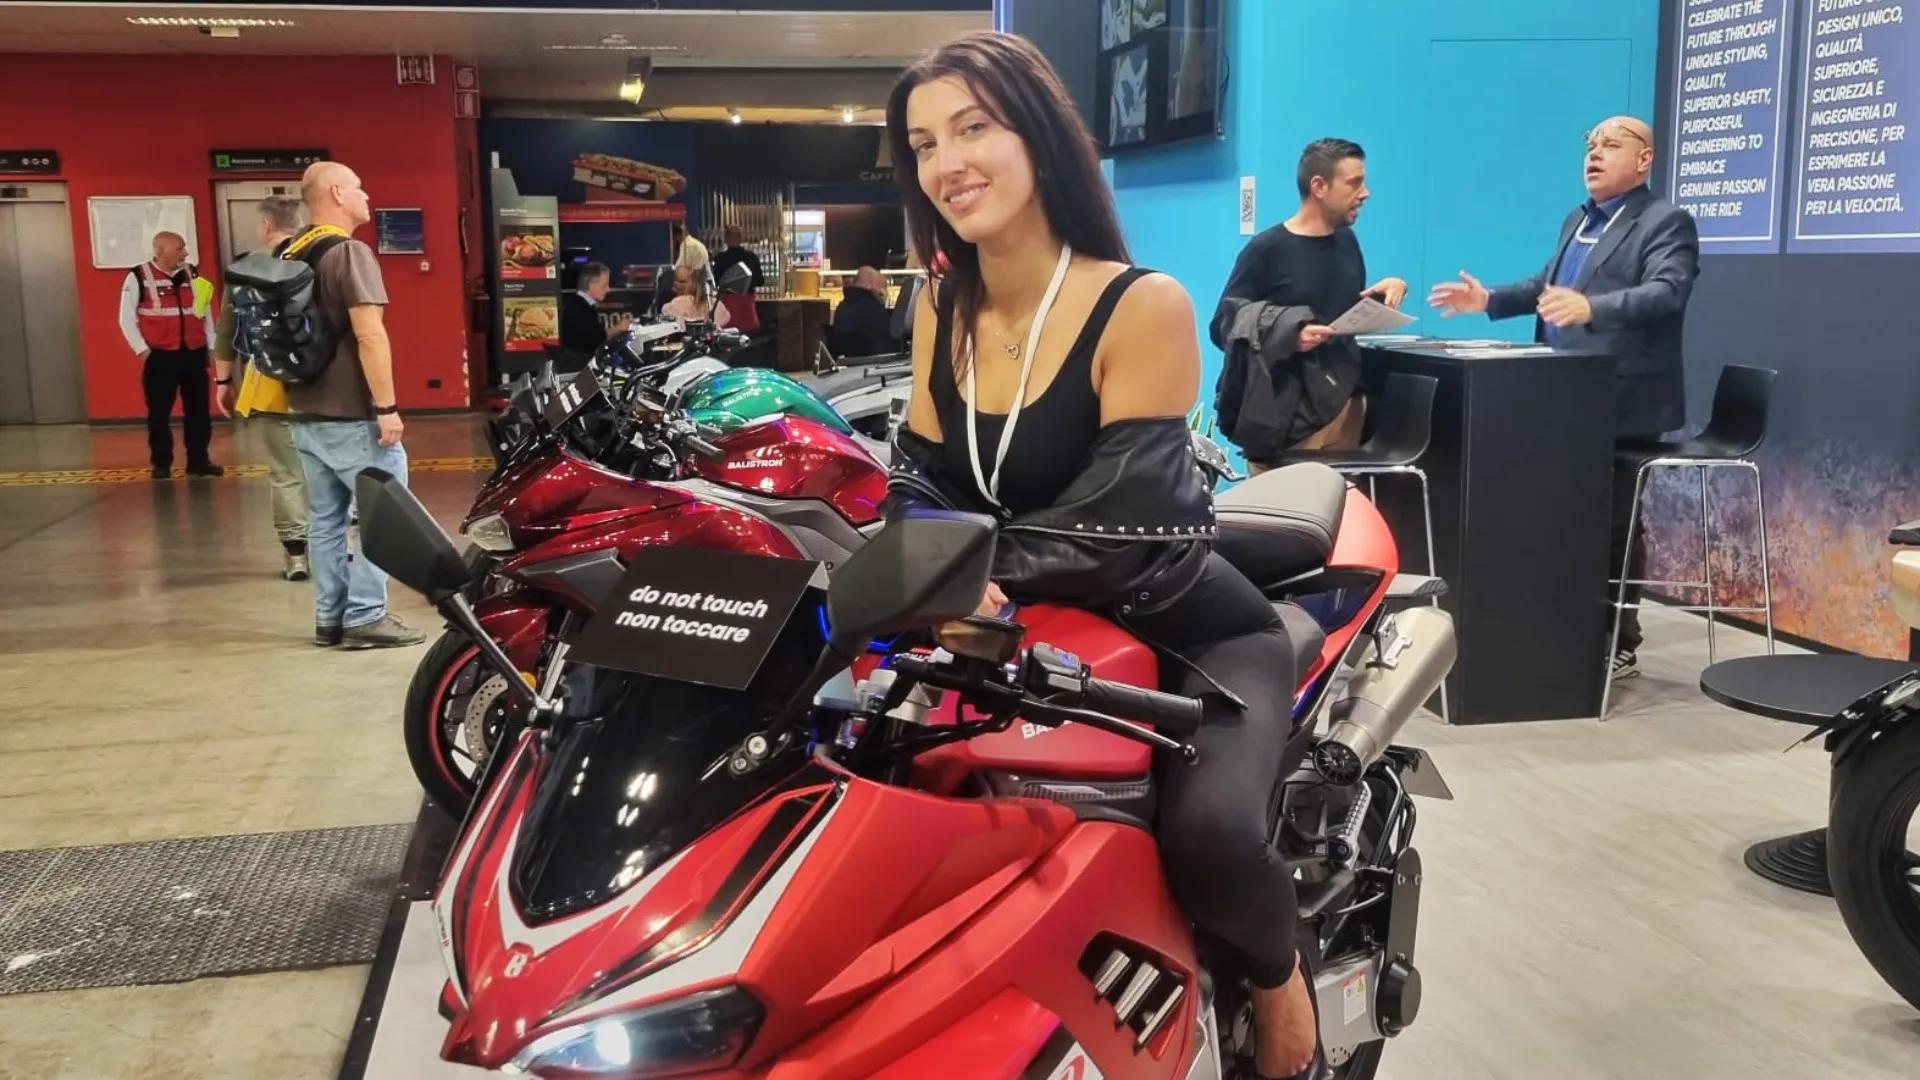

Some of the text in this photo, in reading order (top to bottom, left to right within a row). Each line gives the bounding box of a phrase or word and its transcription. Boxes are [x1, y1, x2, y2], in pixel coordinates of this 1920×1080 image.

[1688, 0, 1763, 27] CELEBRATE THE
[1816, 5, 1903, 36] DESIGN UNICO,
[1686, 18, 1777, 49] FUTURE THROUGH
[1816, 33, 1863, 58] QUALITÀ
[1685, 43, 1768, 71] UNIQUE STYLING,
[1813, 57, 1879, 81] SUPERIORE,
[1684, 71, 1727, 92] QUALITY,
[1812, 80, 1885, 104] SICUREZZA E
[1683, 87, 1772, 113] SUPERIOR SAFETY,
[1682, 114, 1743, 134] PURPOSEFUL
[1811, 102, 1897, 126] INGEGNERIA DI
[1681, 133, 1763, 155] ENGINEERING TO
[1809, 125, 1905, 149] PRECISIONE, PER
[1680, 159, 1726, 177] EMBRACE
[1808, 150, 1885, 171] ESPRIMERE LA
[1679, 178, 1767, 197] GENUINE PASSION
[1807, 173, 1896, 193] VERA PASSIONE
[1699, 202, 1718, 217] THE
[1718, 201, 1743, 217] RIDE
[1804, 192, 1904, 215] PER LA VELOCITÀ.
[727, 459, 783, 470] BALISTRON
[629, 585, 769, 618] do not touch
[615, 610, 750, 643] non toccare
